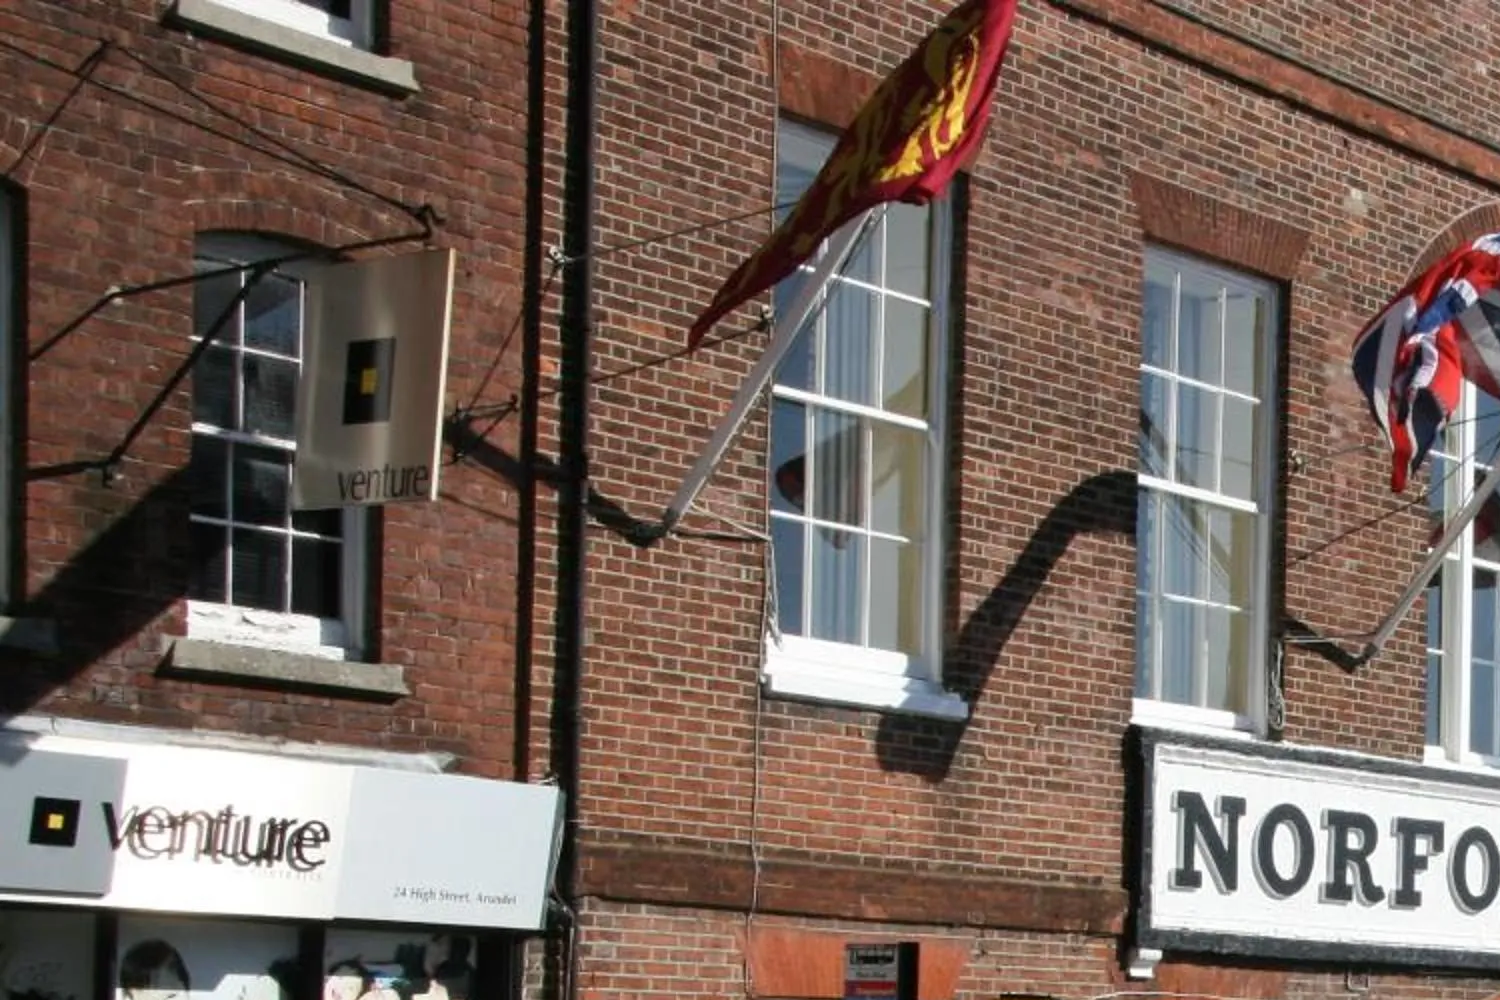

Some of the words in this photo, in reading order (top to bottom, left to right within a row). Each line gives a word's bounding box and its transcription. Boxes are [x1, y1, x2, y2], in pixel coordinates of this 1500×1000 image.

[338, 463, 428, 501] venture
[102, 802, 331, 872] venture
[411, 887, 436, 903] High
